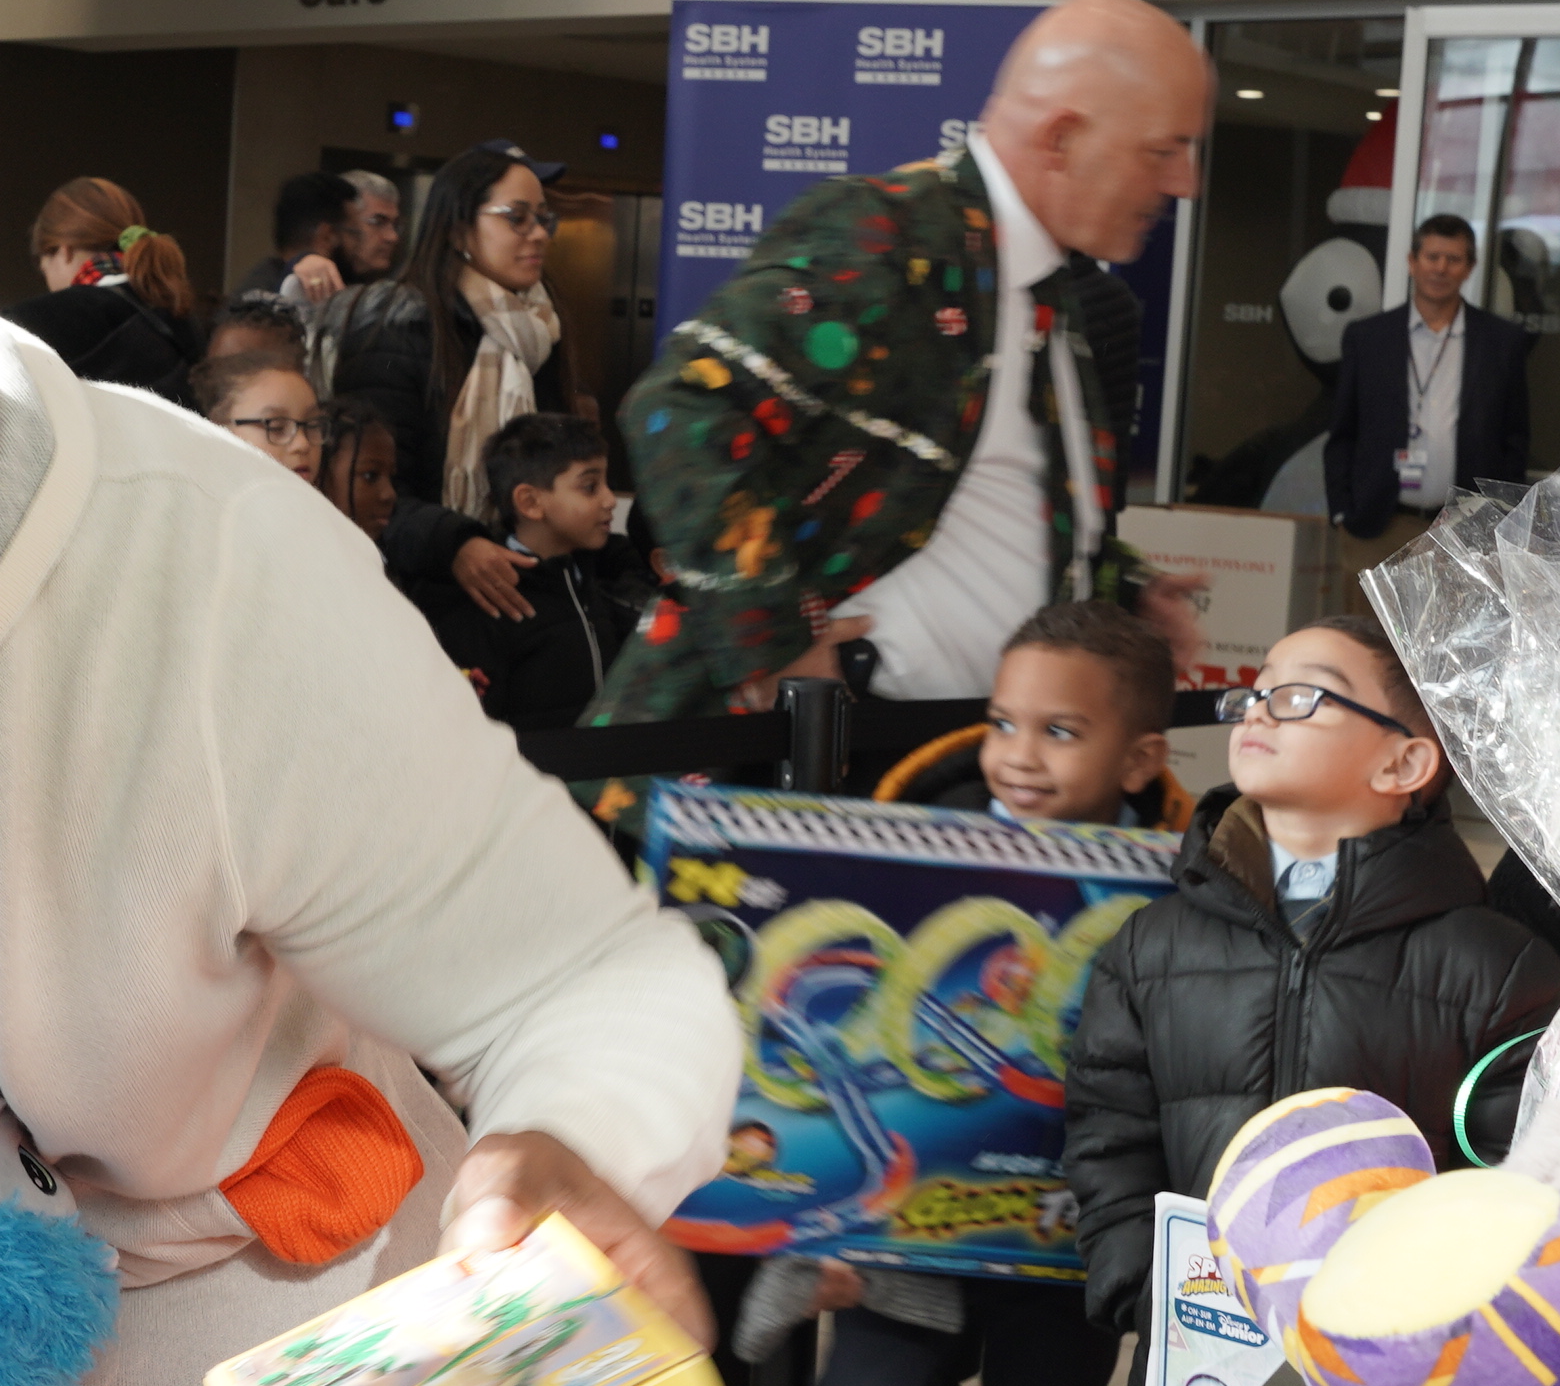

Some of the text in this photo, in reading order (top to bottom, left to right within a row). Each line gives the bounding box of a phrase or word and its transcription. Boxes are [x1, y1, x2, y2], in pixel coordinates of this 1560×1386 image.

[684, 23, 770, 54] SBH
[856, 26, 944, 58] SBH
[764, 114, 850, 146] SBH
[679, 200, 763, 232] SBH
[1181, 1278, 1227, 1297] AMAZING
[1218, 1323, 1265, 1346] Junior
